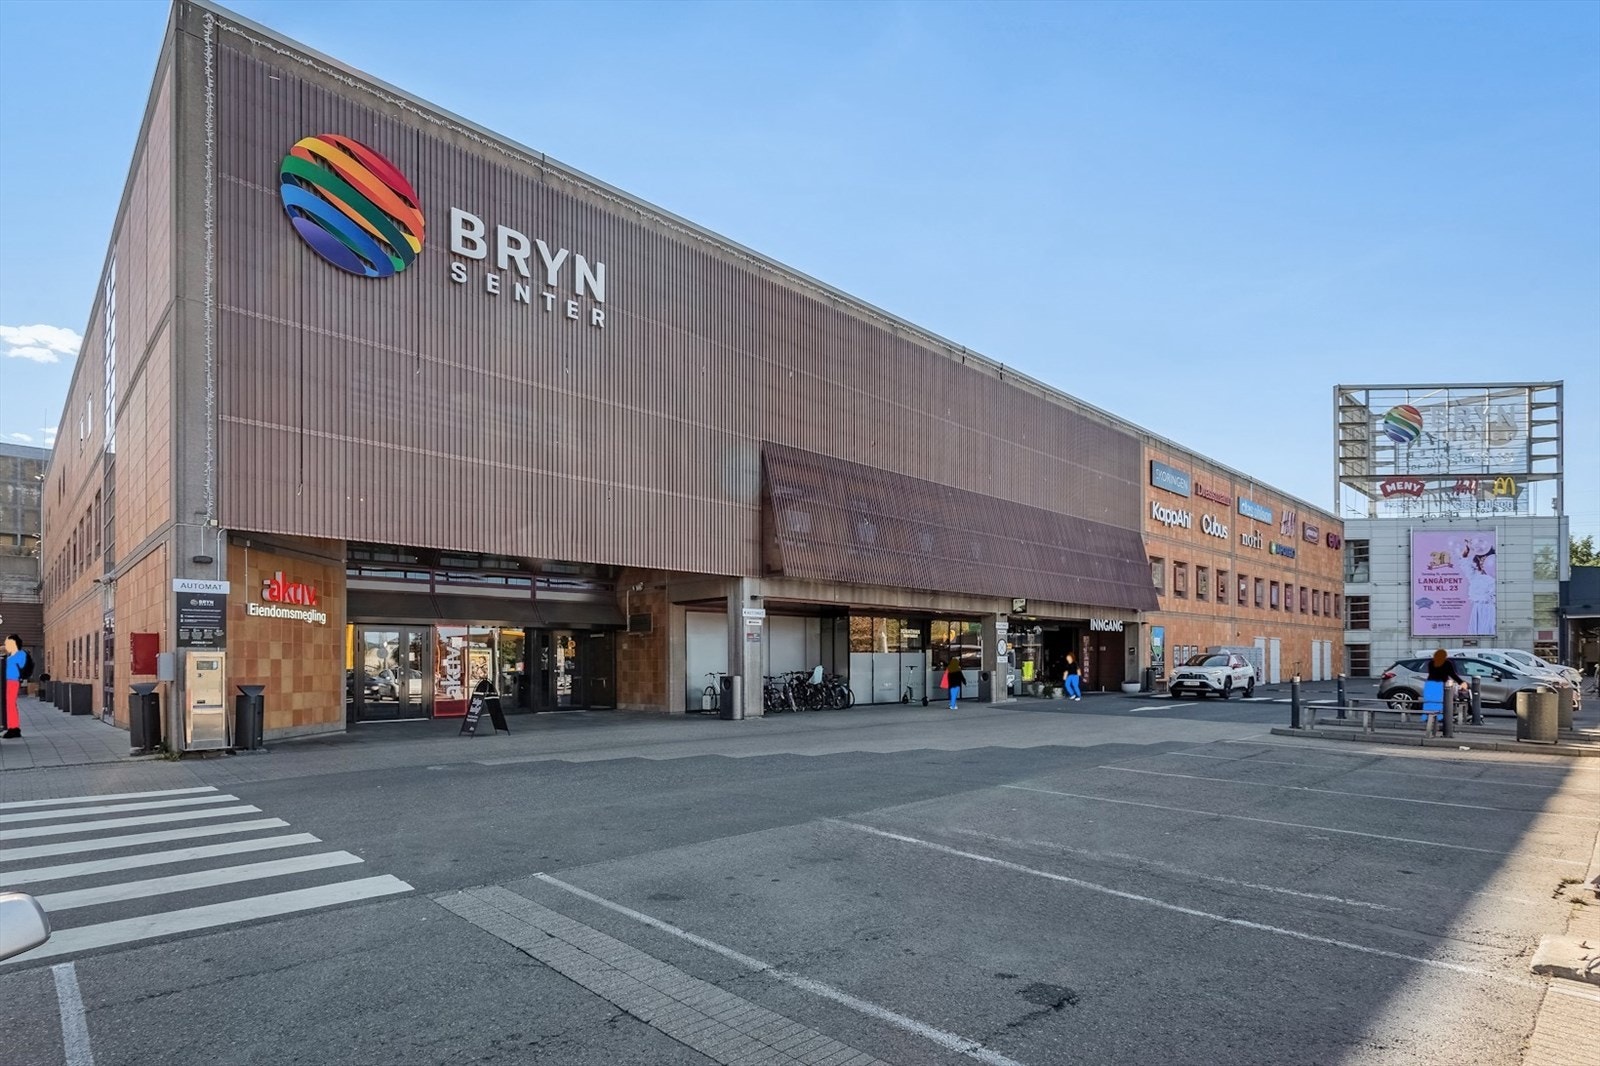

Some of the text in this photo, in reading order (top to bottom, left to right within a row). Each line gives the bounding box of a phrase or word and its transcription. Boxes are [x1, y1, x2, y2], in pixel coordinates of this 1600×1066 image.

[451, 207, 606, 303] BRYN
[451, 262, 605, 328] SENTER
[1431, 406, 1515, 428] BRYN
[1386, 481, 1421, 493] MENY
[1152, 501, 1192, 529] KappAhl
[1202, 514, 1229, 539] Cubus
[1241, 530, 1263, 549] norli
[180, 582, 223, 590] AUTOMAT
[1418, 575, 1463, 584] LANGÅPENT
[248, 602, 327, 625] Eiendomsmegling
[1090, 618, 1124, 632] INNGANG
